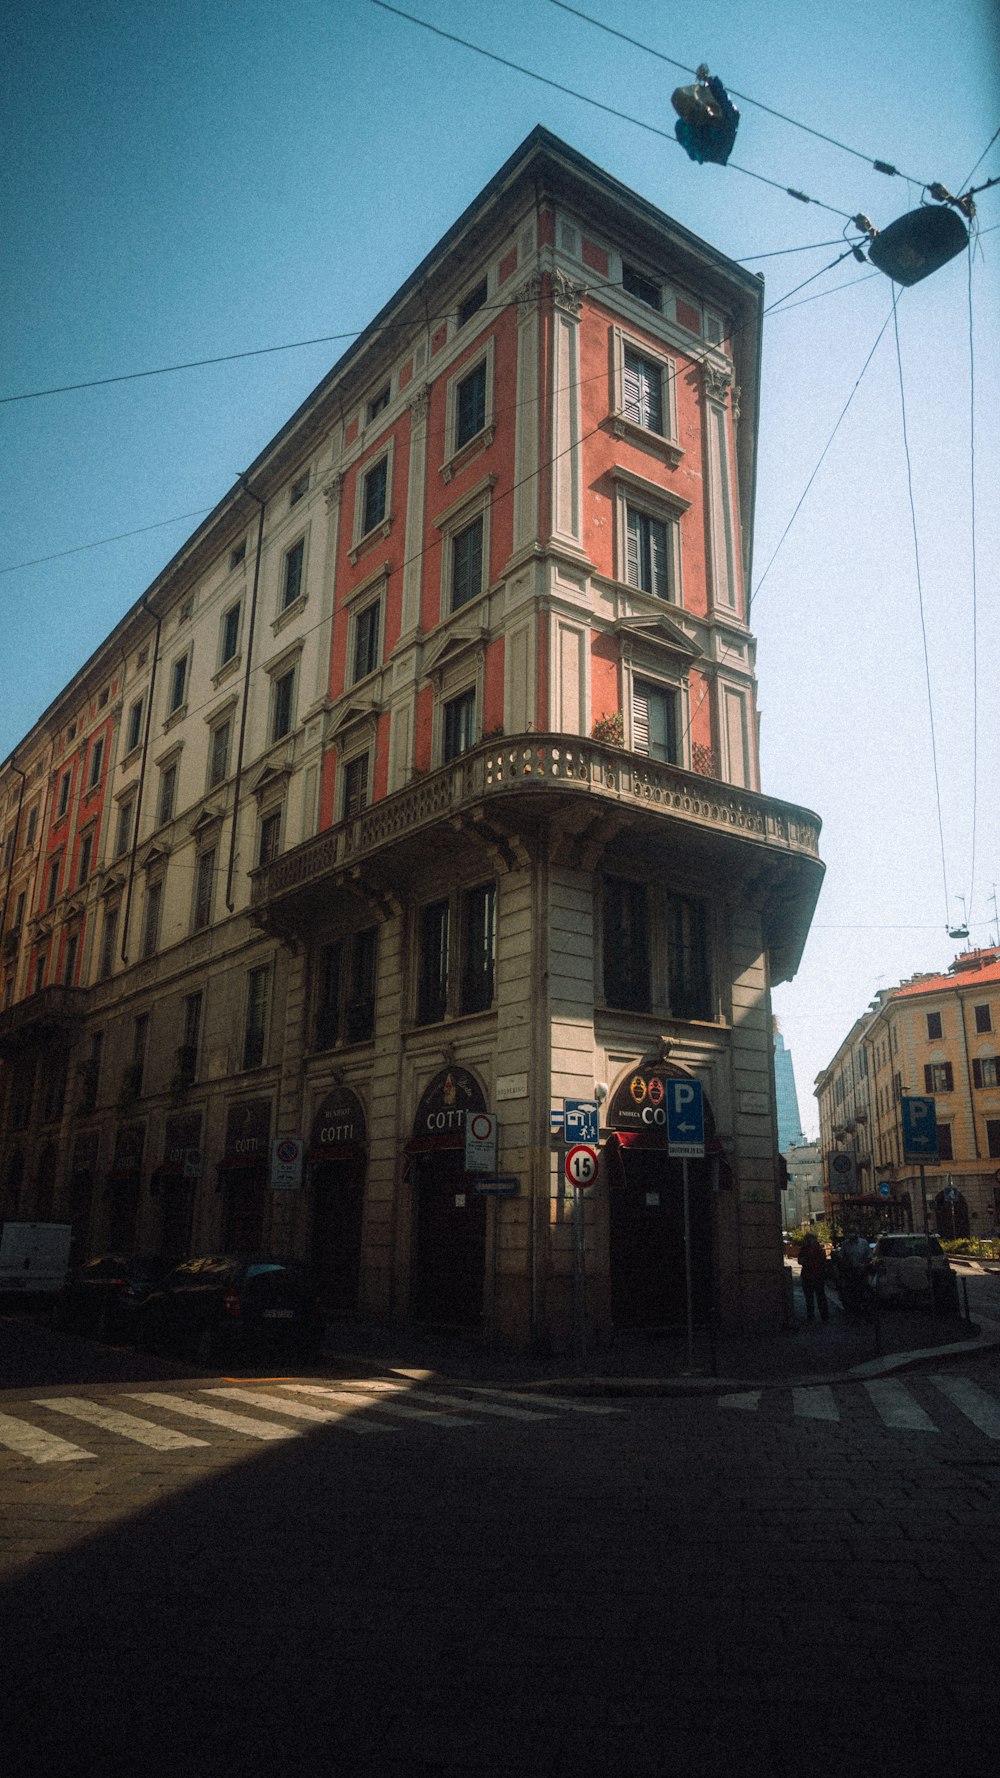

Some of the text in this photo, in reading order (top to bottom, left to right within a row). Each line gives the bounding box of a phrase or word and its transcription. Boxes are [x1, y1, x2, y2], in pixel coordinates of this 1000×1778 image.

[674, 1083, 695, 1113] P
[426, 1108, 469, 1130] COTT
[641, 1106, 667, 1126] CO
[908, 1100, 928, 1127] P
[320, 1124, 354, 1143] COTTI
[235, 1137, 259, 1153] COTTI
[574, 1157, 592, 1177] 15
